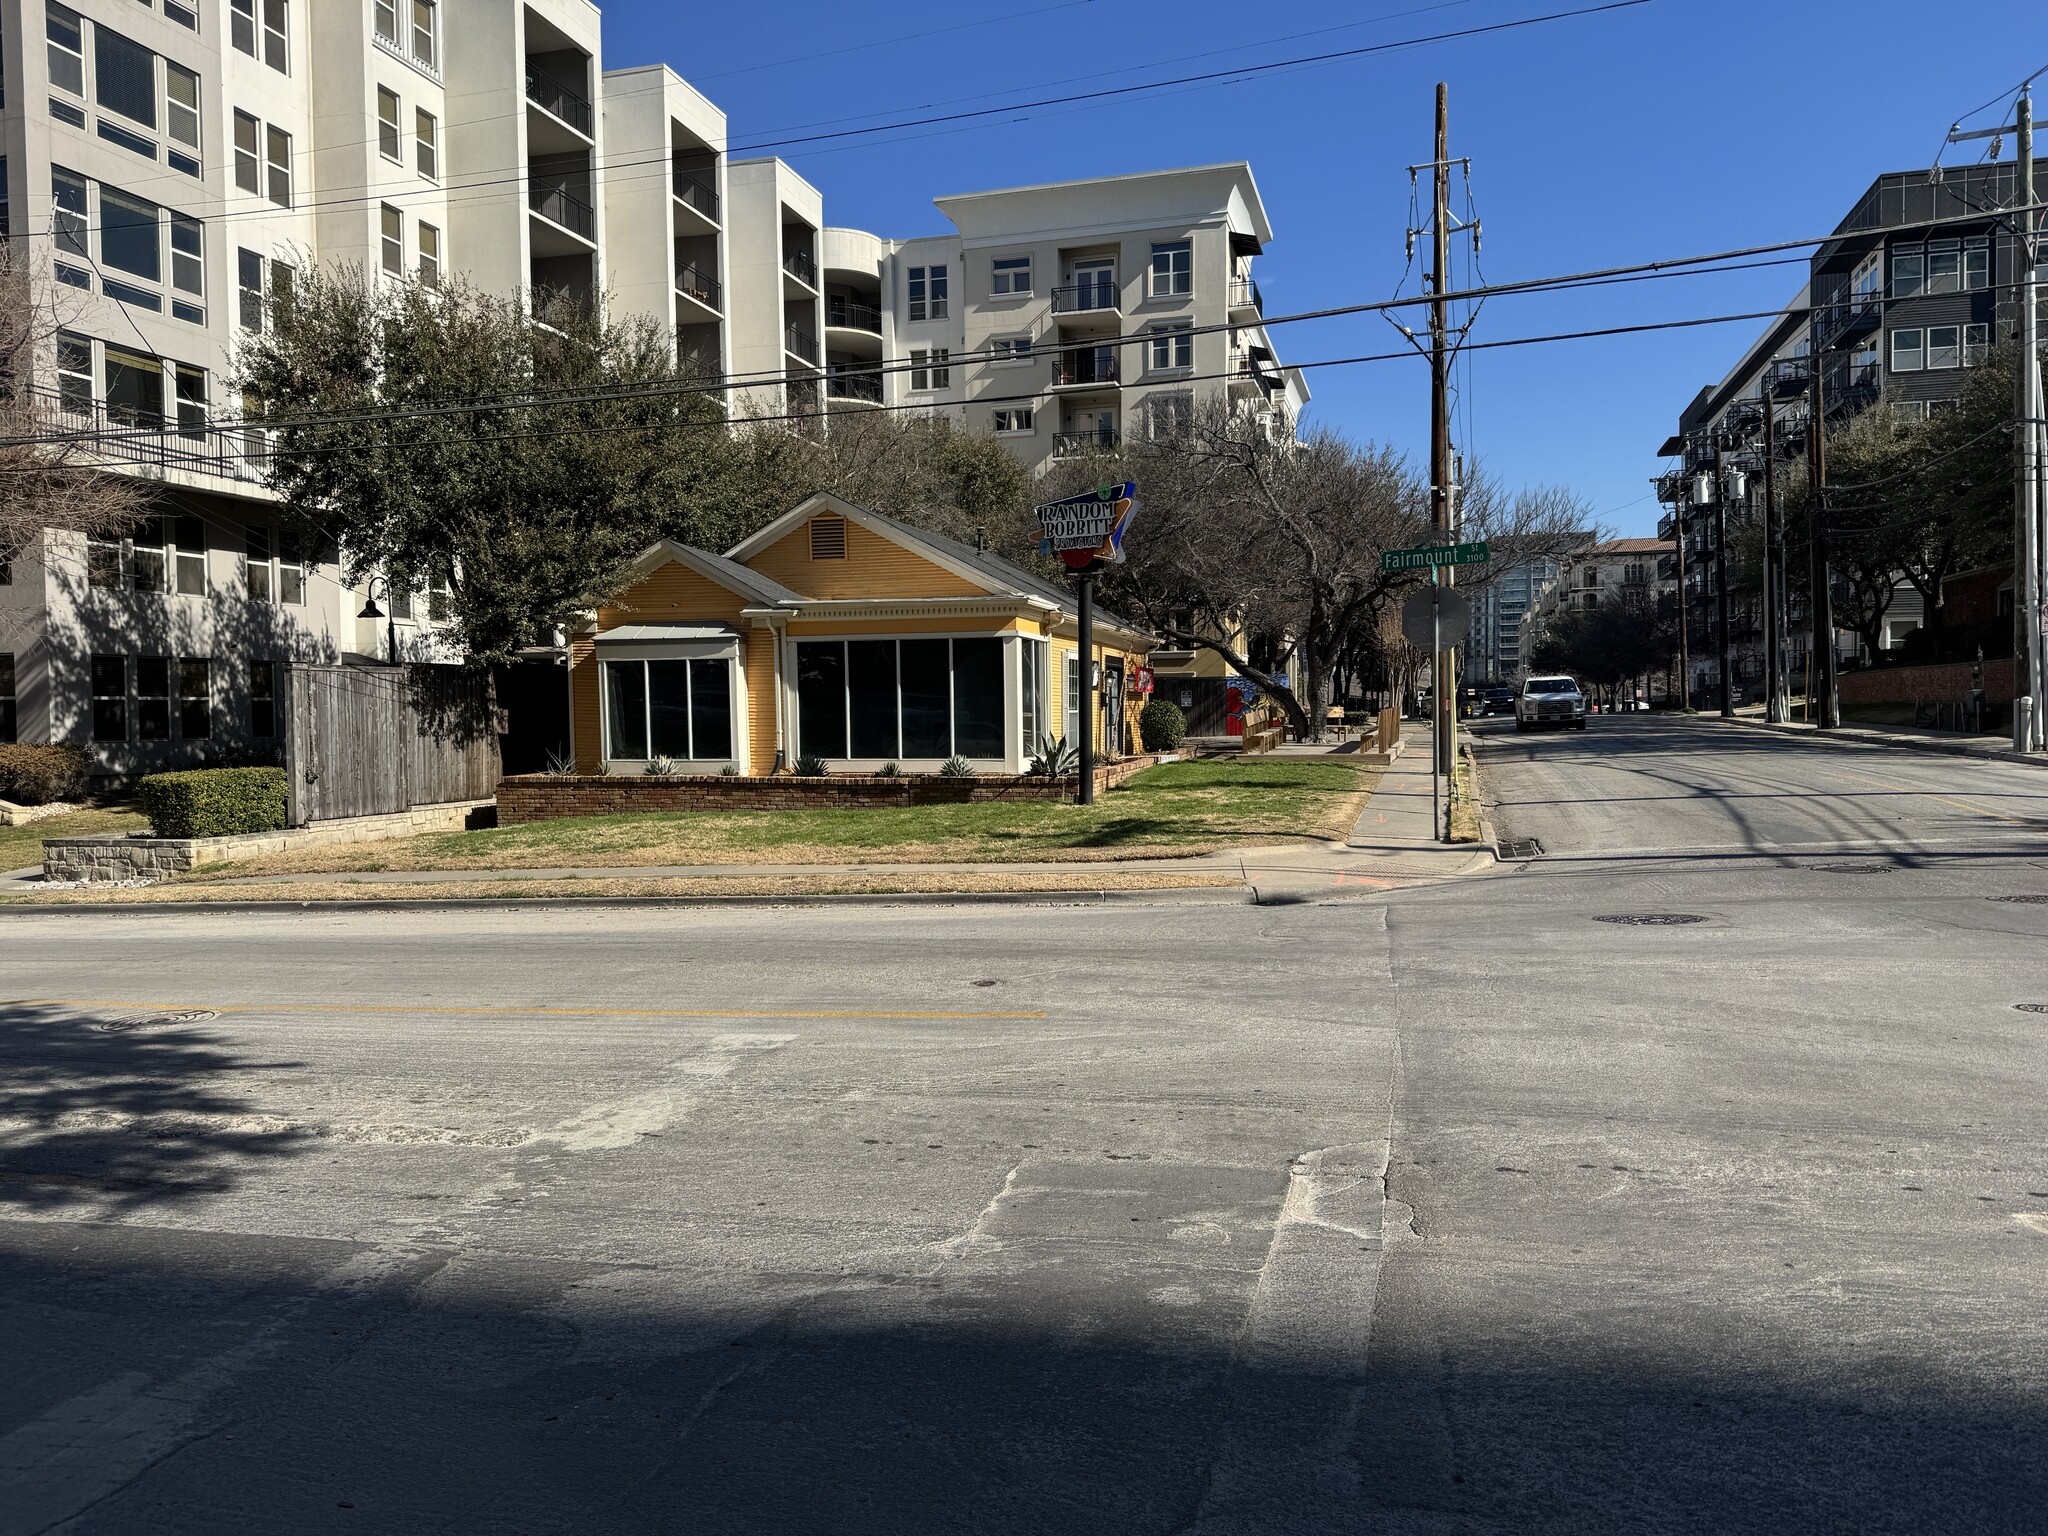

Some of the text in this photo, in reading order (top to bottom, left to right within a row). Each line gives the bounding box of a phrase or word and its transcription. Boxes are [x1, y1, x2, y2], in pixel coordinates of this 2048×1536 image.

[1043, 502, 1115, 521] RANDOM
[1045, 519, 1111, 537] BOBBITT
[1385, 544, 1479, 568] Fairmount St
[1466, 553, 1484, 562] 3100
